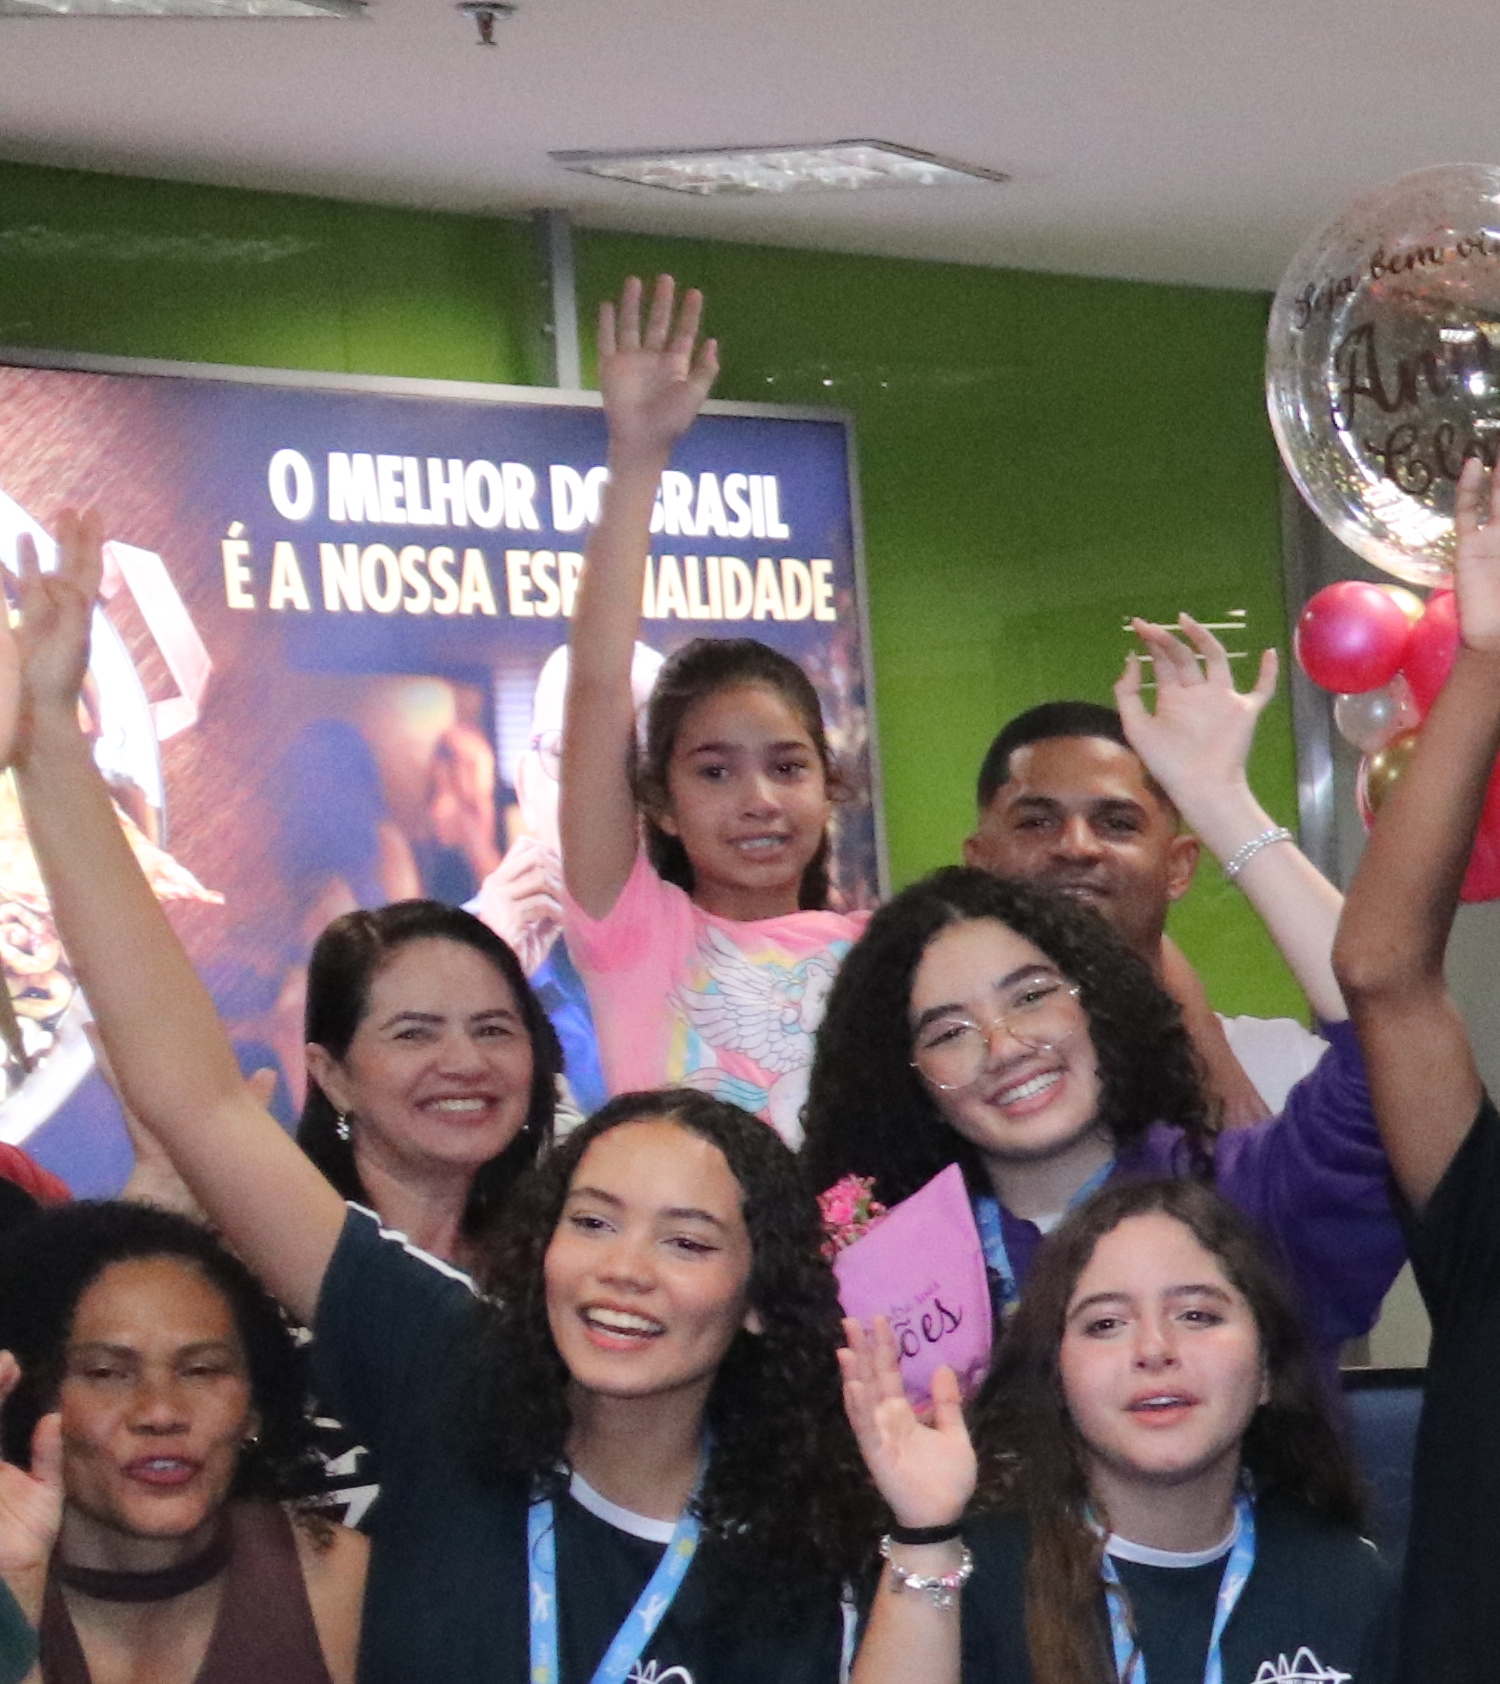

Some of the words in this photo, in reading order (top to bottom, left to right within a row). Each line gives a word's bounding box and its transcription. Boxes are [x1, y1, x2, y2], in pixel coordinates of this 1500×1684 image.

[269, 448, 315, 521] O
[328, 452, 541, 531] MELHOR
[221, 521, 255, 609] É
[269, 541, 311, 611] A
[319, 542, 497, 616] NOSSA
[505, 549, 837, 622] ESPIALIDADE
